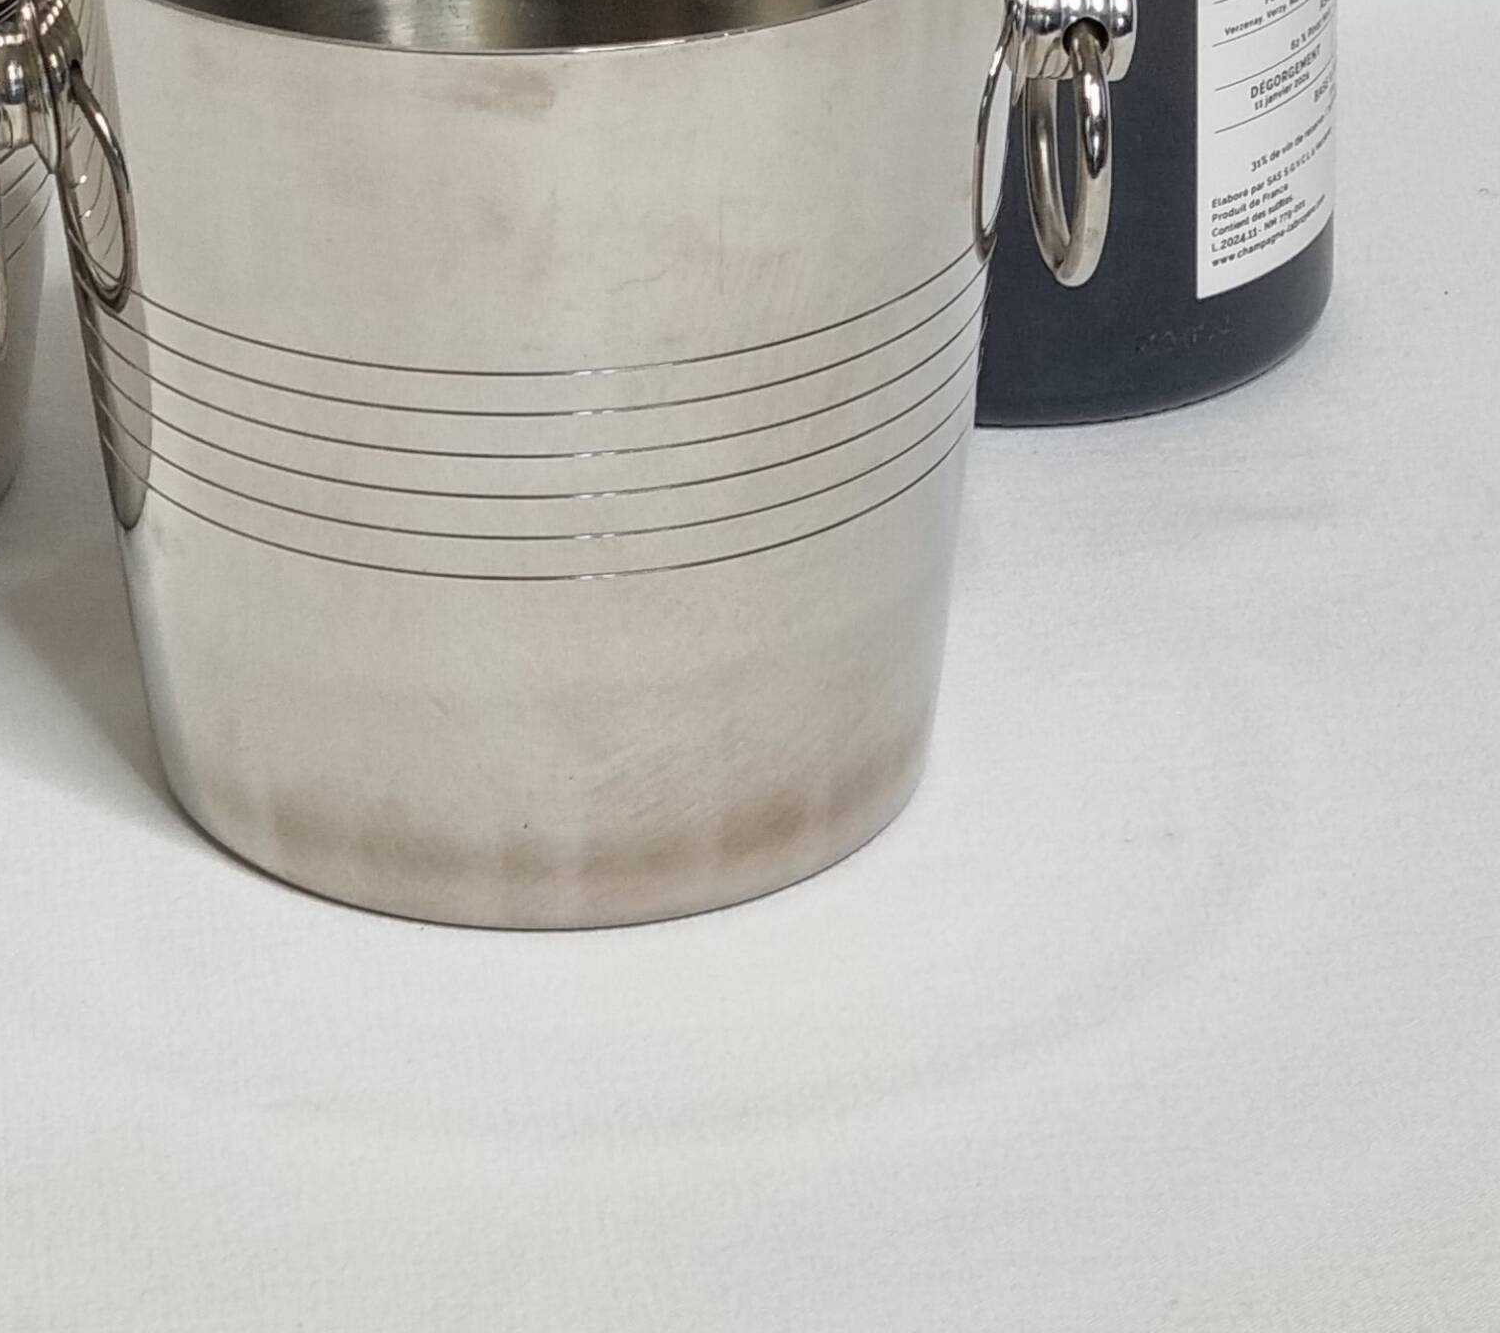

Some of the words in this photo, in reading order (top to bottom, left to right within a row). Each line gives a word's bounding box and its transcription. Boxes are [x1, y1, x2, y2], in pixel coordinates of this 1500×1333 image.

[1250, 43, 1320, 98] DÉGORGEMENT
[1250, 155, 1268, 171] 31%
[1269, 149, 1280, 161] de
[1250, 182, 1265, 195] par
[1266, 171, 1282, 185] SAS
[1211, 203, 1246, 222] Produit
[1248, 196, 1261, 208] de
[1262, 183, 1288, 202] France
[1211, 215, 1250, 237] Contient
[1251, 208, 1266, 221] des
